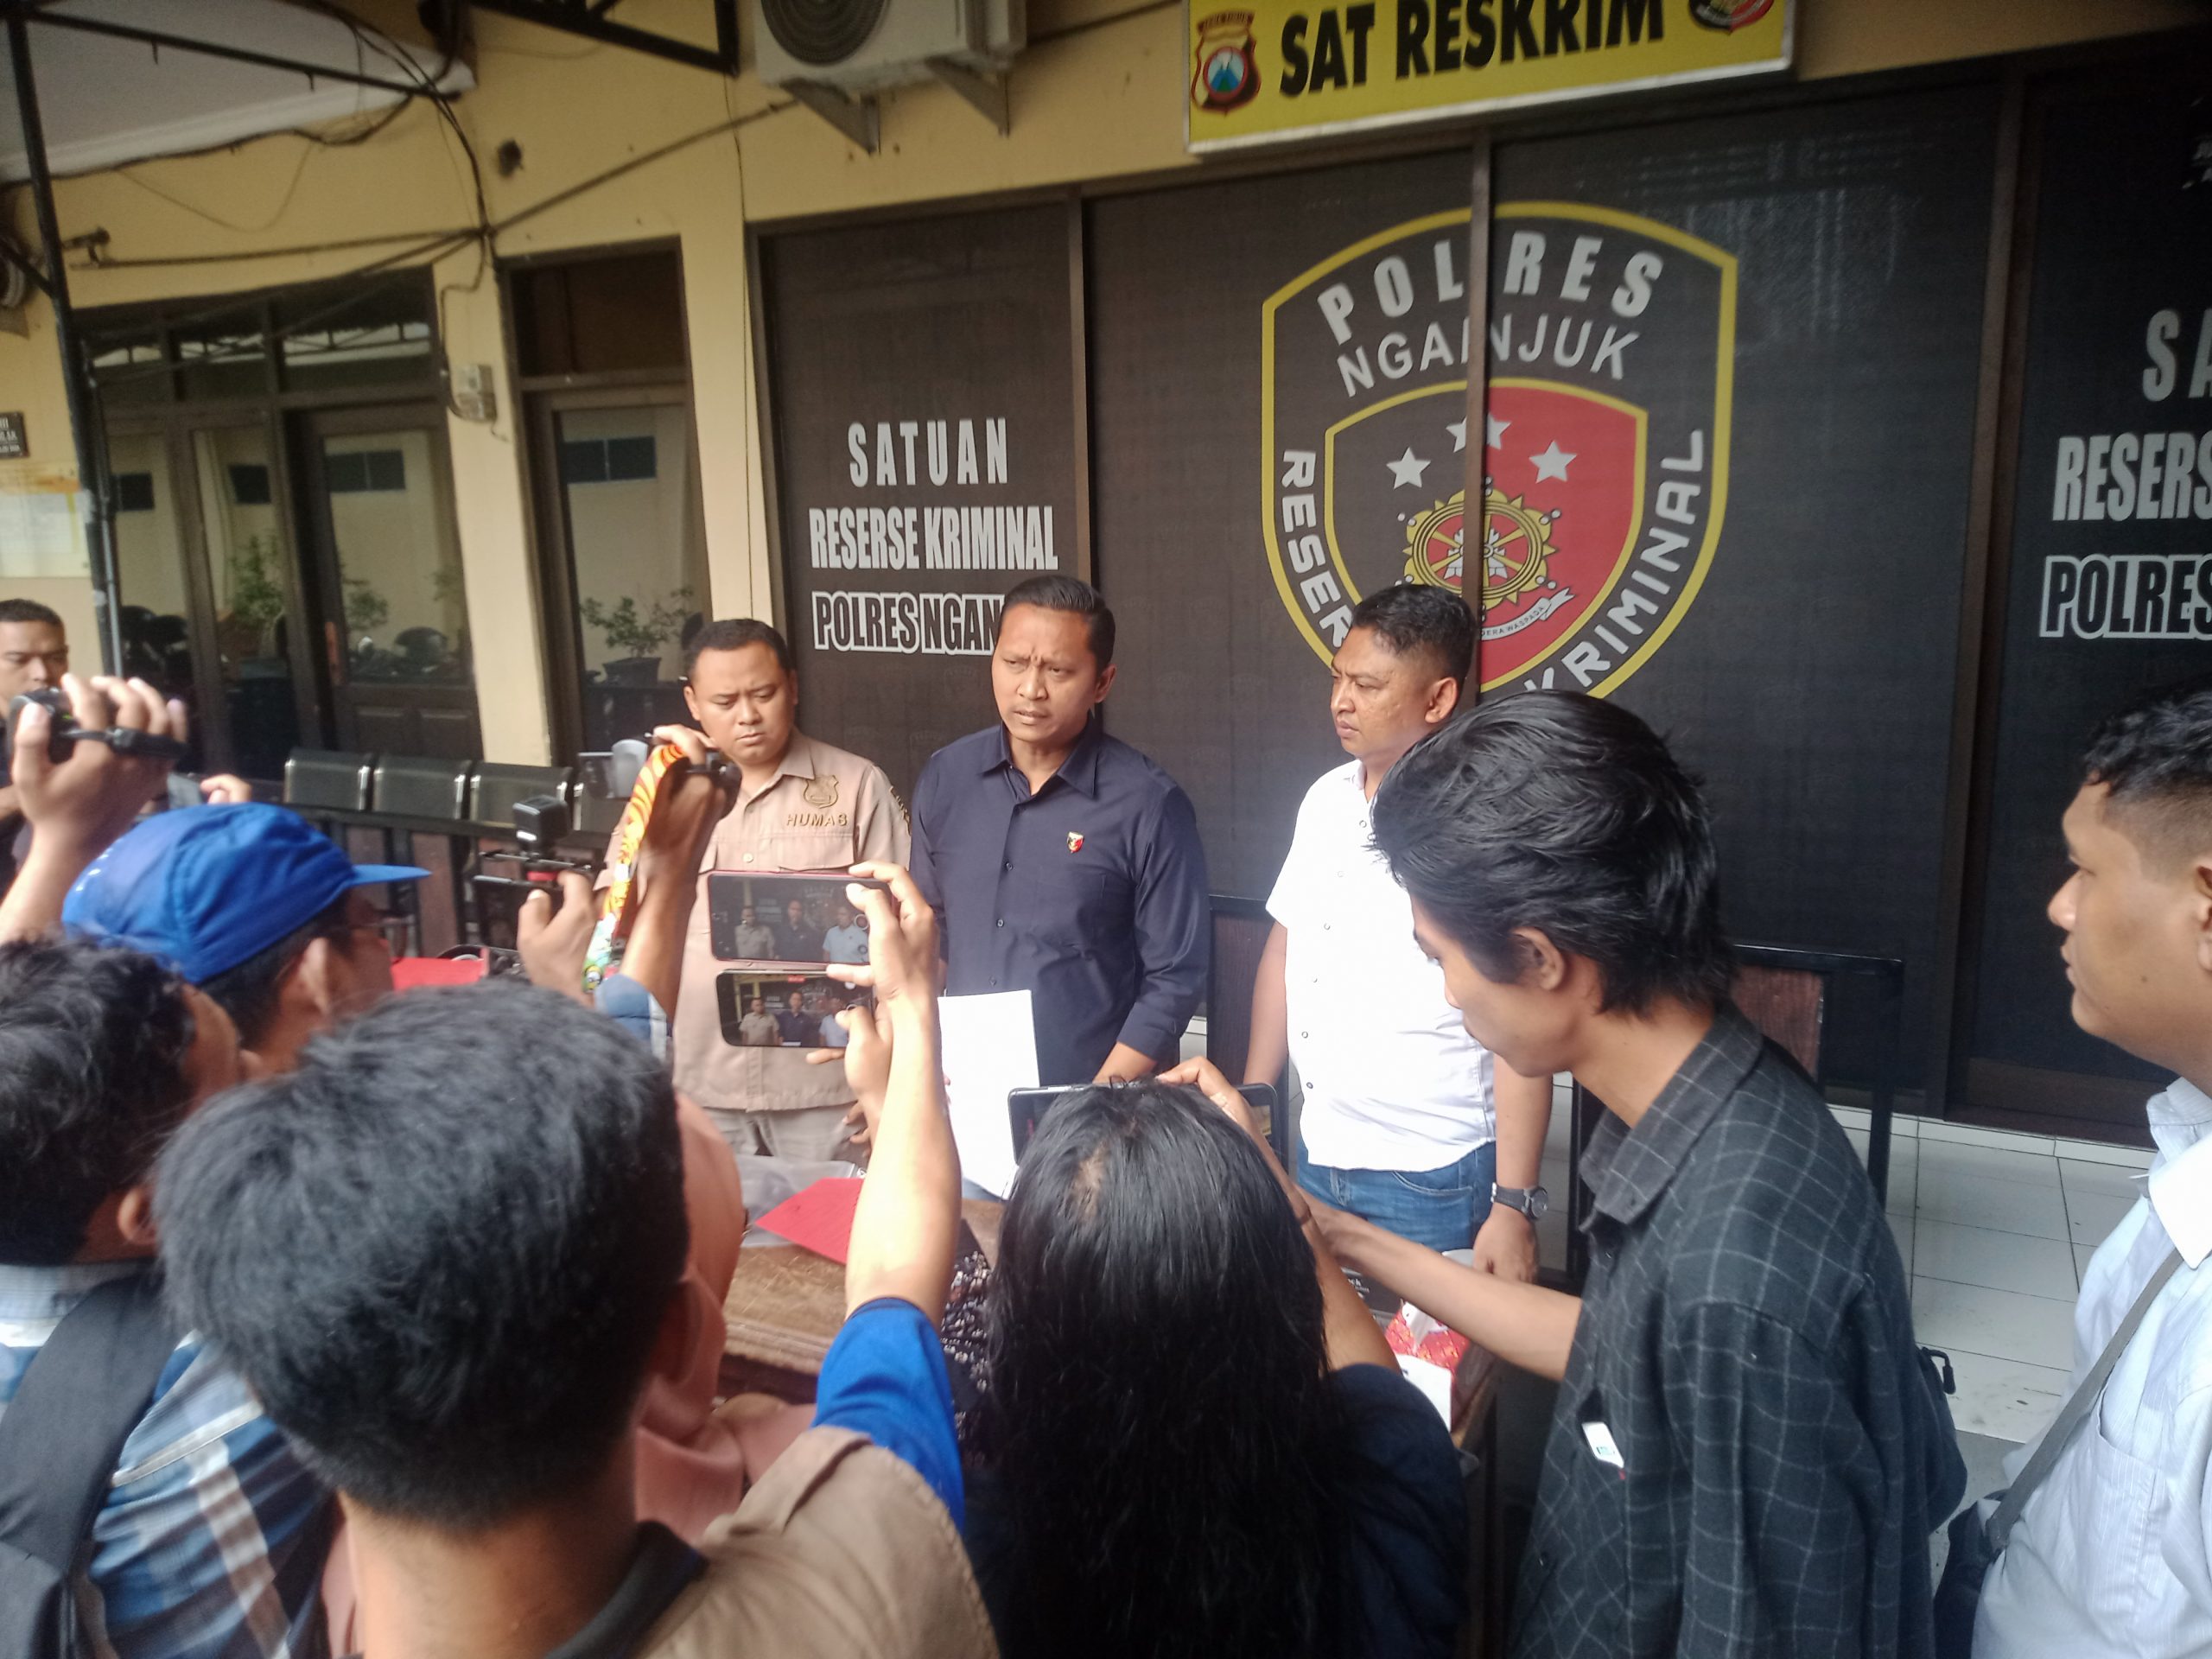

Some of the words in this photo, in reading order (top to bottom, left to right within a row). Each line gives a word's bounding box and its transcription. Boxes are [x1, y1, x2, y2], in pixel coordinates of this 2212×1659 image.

[1278, 3, 1376, 98] SAT
[1395, 0, 1664, 79] RESKRIM
[1317, 231, 1664, 345] POLRES
[1338, 313, 1639, 397] NGANJUK
[848, 417, 1007, 487] SATUAN
[809, 506, 919, 570] RESERSE
[924, 505, 1058, 570] KRIMINAL
[1281, 449, 1353, 648] RESER
[812, 591, 919, 653] POLRES
[785, 813, 848, 827] HUMAS
